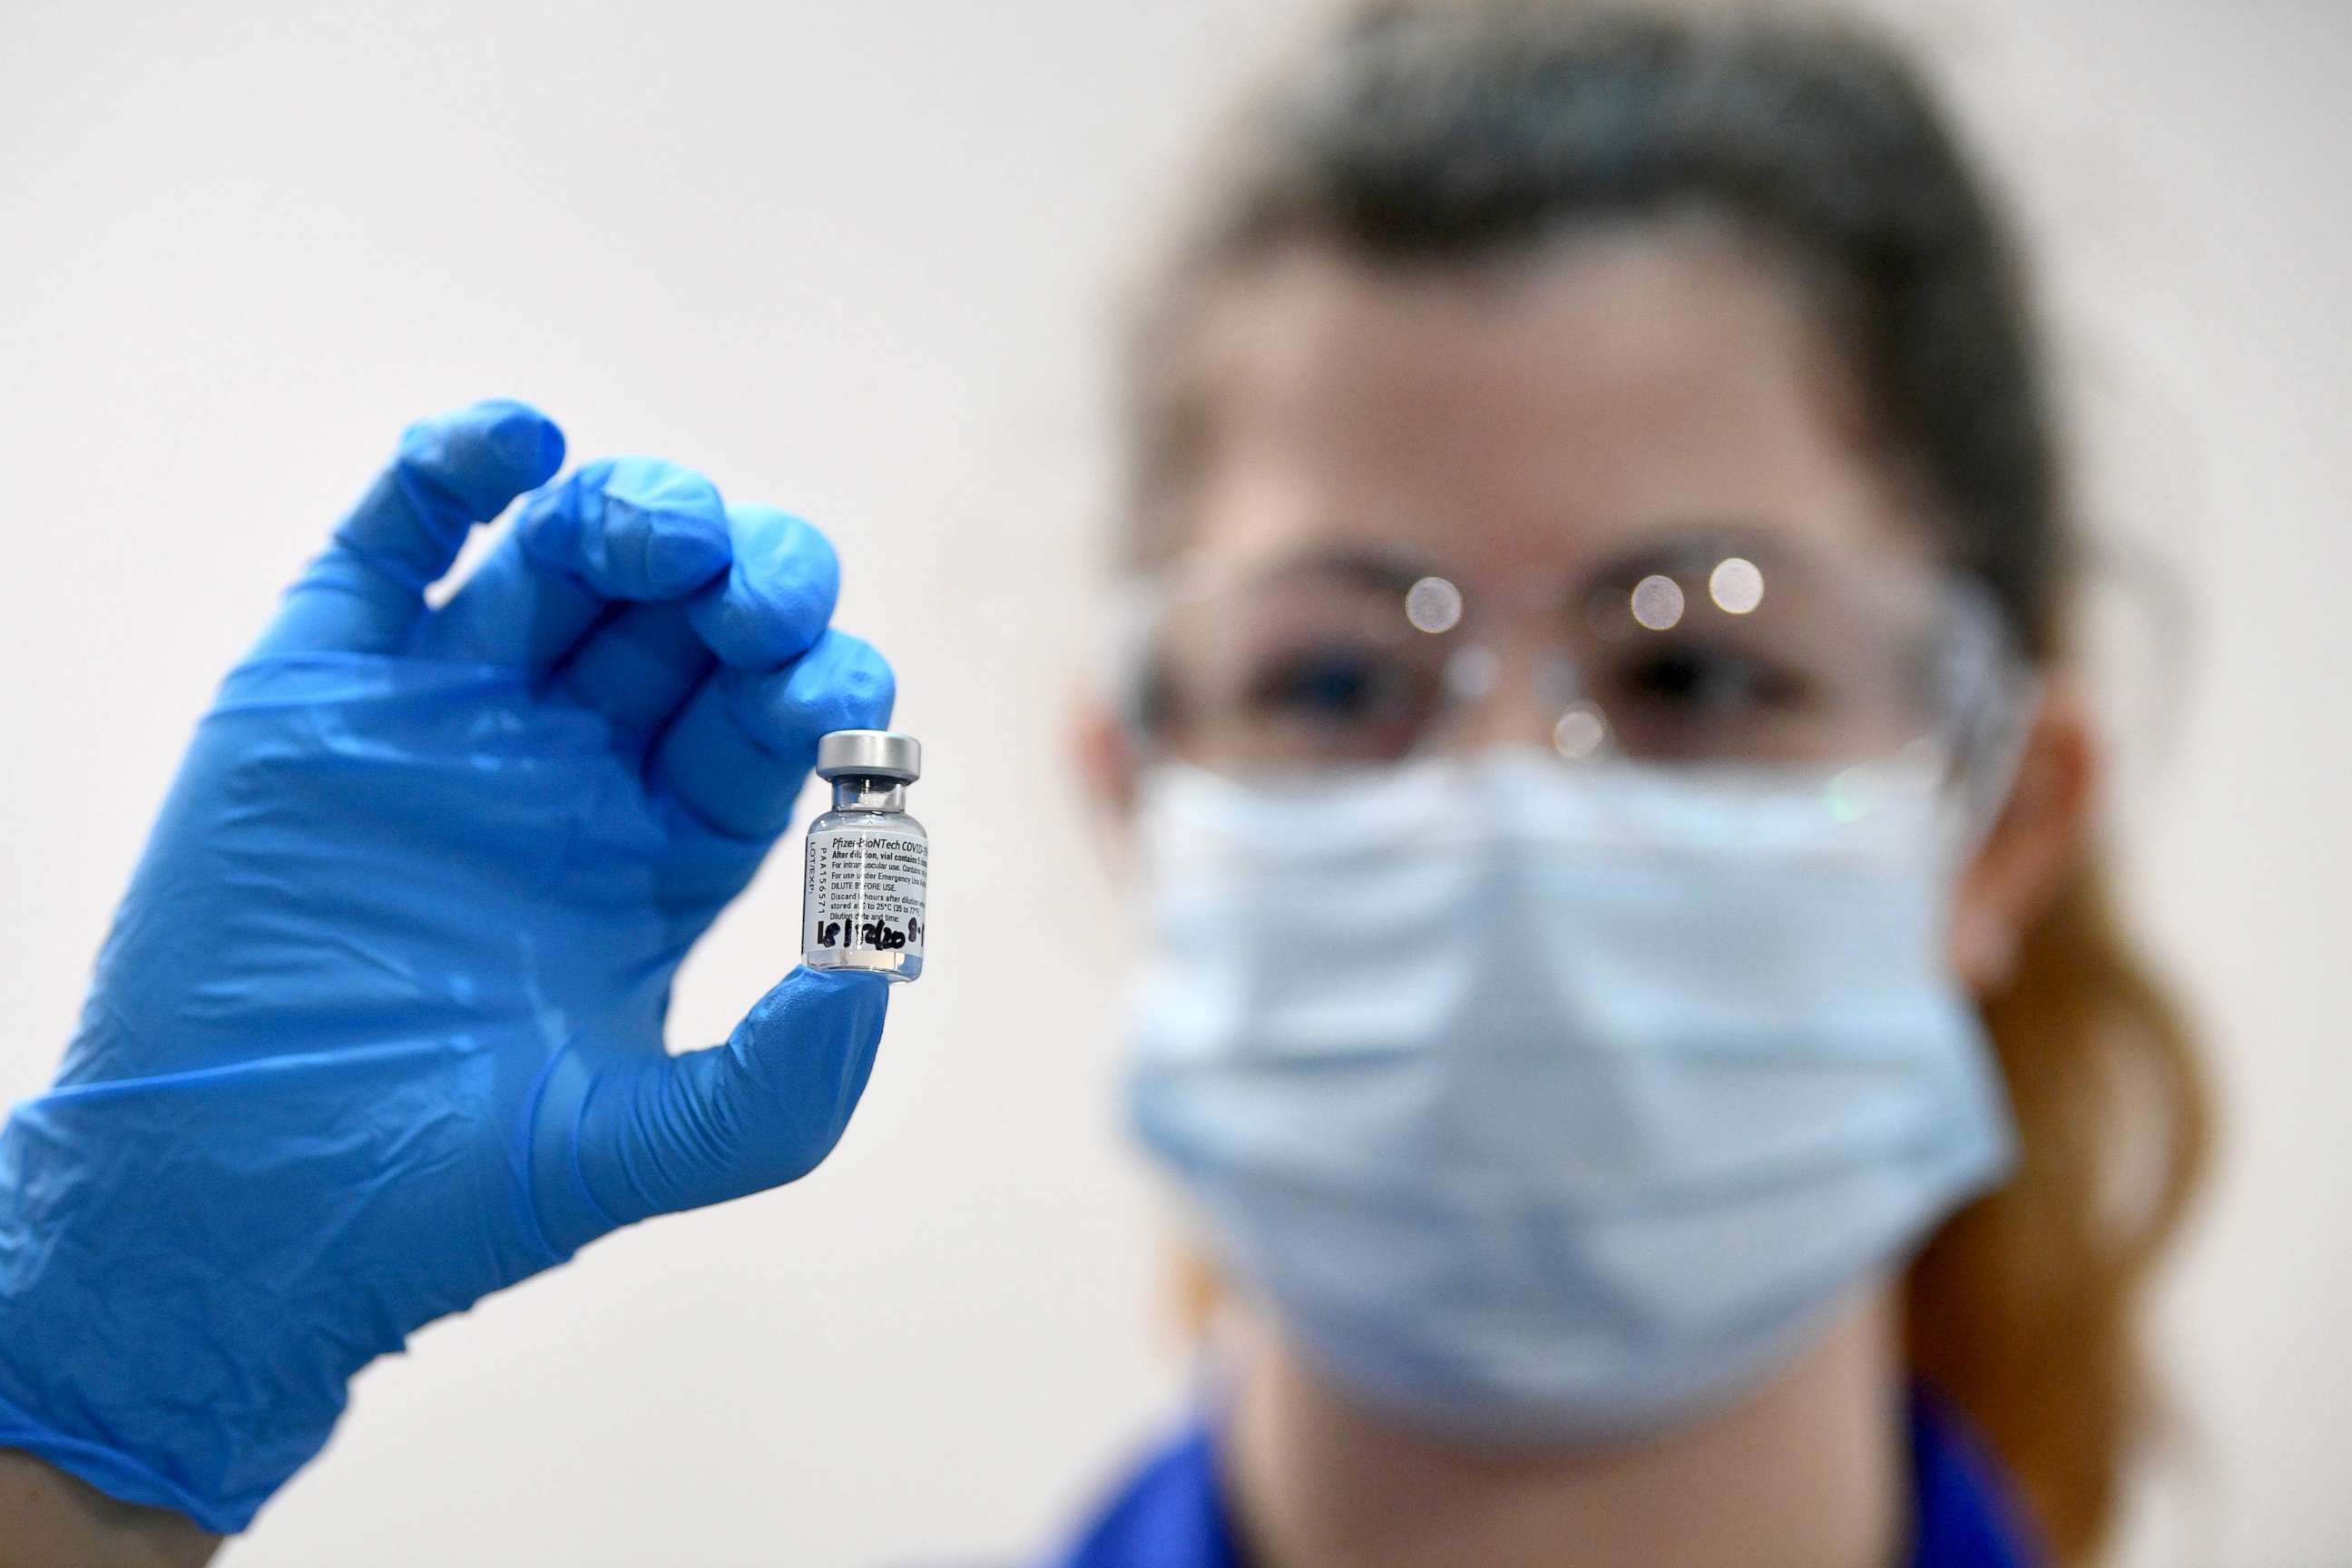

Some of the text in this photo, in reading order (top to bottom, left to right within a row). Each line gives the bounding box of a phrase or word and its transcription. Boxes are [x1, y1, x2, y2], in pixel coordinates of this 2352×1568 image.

[832, 851, 848, 859] After
[849, 850, 879, 860] diluion,
[880, 851, 893, 860] vial
[895, 853, 917, 865] contains
[818, 848, 827, 914] PAA156571
[856, 872, 876, 880] uder
[878, 873, 910, 885] Emergency
[831, 882, 853, 890] DILUTE
[855, 882, 881, 891] BFORE
[864, 893, 884, 901] hours
[886, 894, 900, 903] after
[867, 902, 875, 910] to
[829, 912, 853, 920] Dilution
[855, 912, 869, 920] dte
[885, 914, 900, 923] time:
